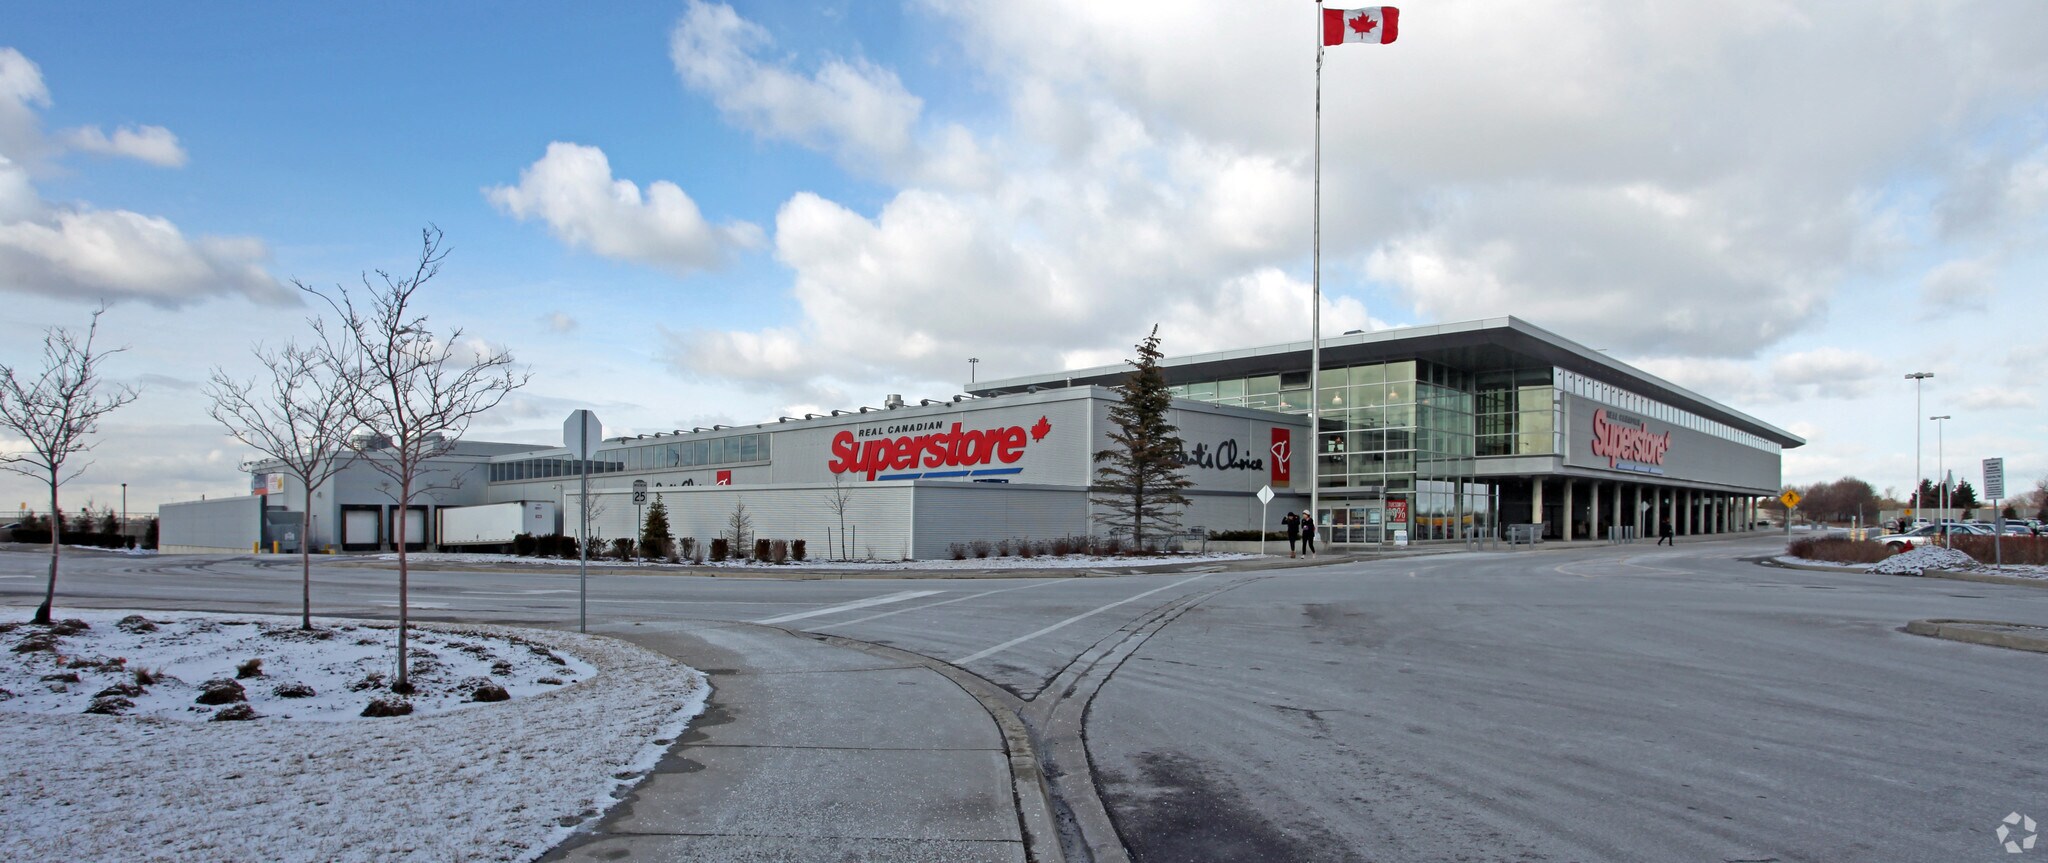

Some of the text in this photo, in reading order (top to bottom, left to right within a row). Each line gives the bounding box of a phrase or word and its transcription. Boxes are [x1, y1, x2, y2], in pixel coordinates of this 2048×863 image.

[858, 421, 943, 437] REAL CANADIAN
[1591, 408, 1664, 468] Superstore
[828, 422, 1027, 481] Superstore
[634, 491, 646, 502] 25
